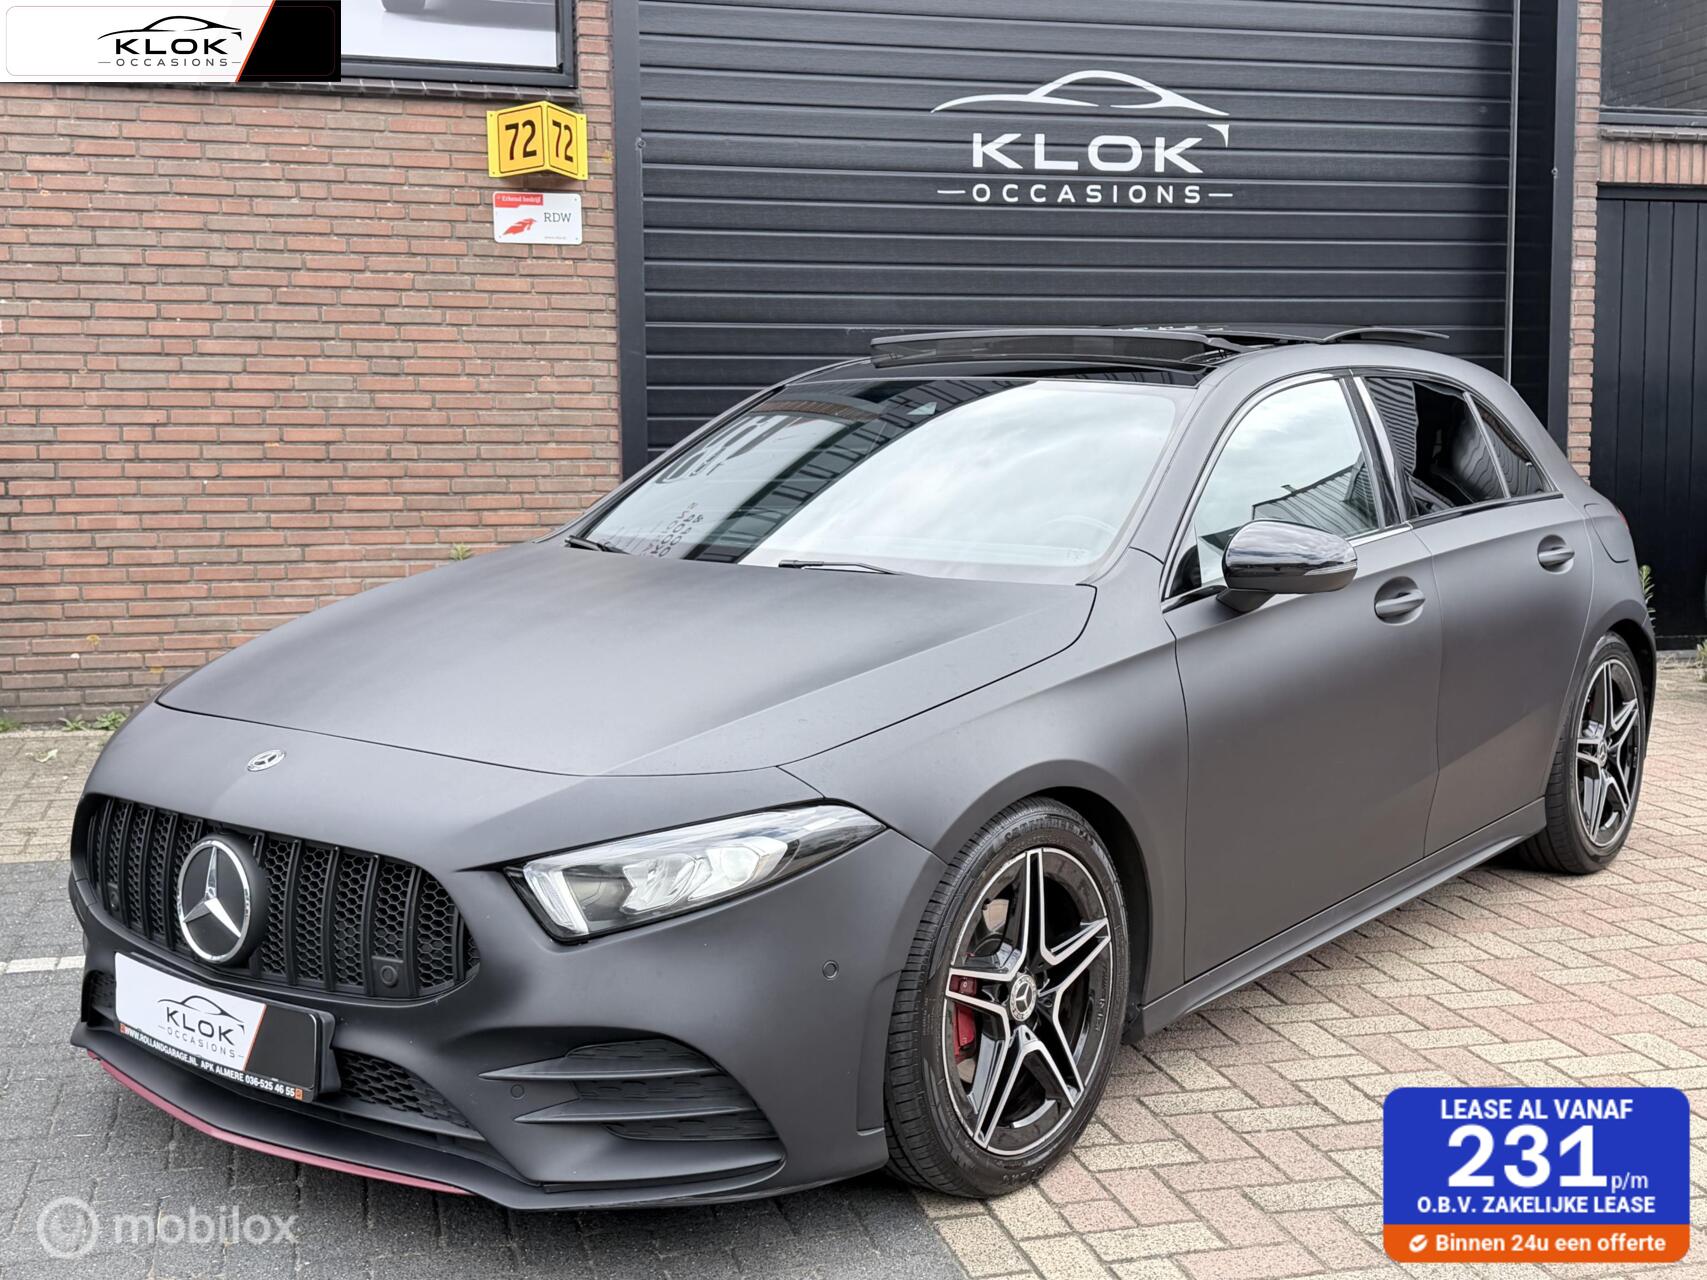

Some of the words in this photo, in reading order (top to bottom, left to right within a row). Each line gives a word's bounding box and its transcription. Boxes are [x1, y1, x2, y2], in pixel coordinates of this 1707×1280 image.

[505, 120, 537, 160] 72
[552, 119, 574, 163] 72
[972, 133, 1203, 173] KLOK
[972, 183, 1200, 204] OCCASIONS
[544, 212, 572, 223] RDW
[166, 1007, 235, 1046] KLOK
[167, 1026, 235, 1058] OCCASIONS
[200, 1060, 215, 1072] APK
[215, 1065, 245, 1082] ALMERE
[245, 1074, 274, 1091] 036-525
[274, 1083, 285, 1095] 46
[285, 1086, 295, 1097] 55
